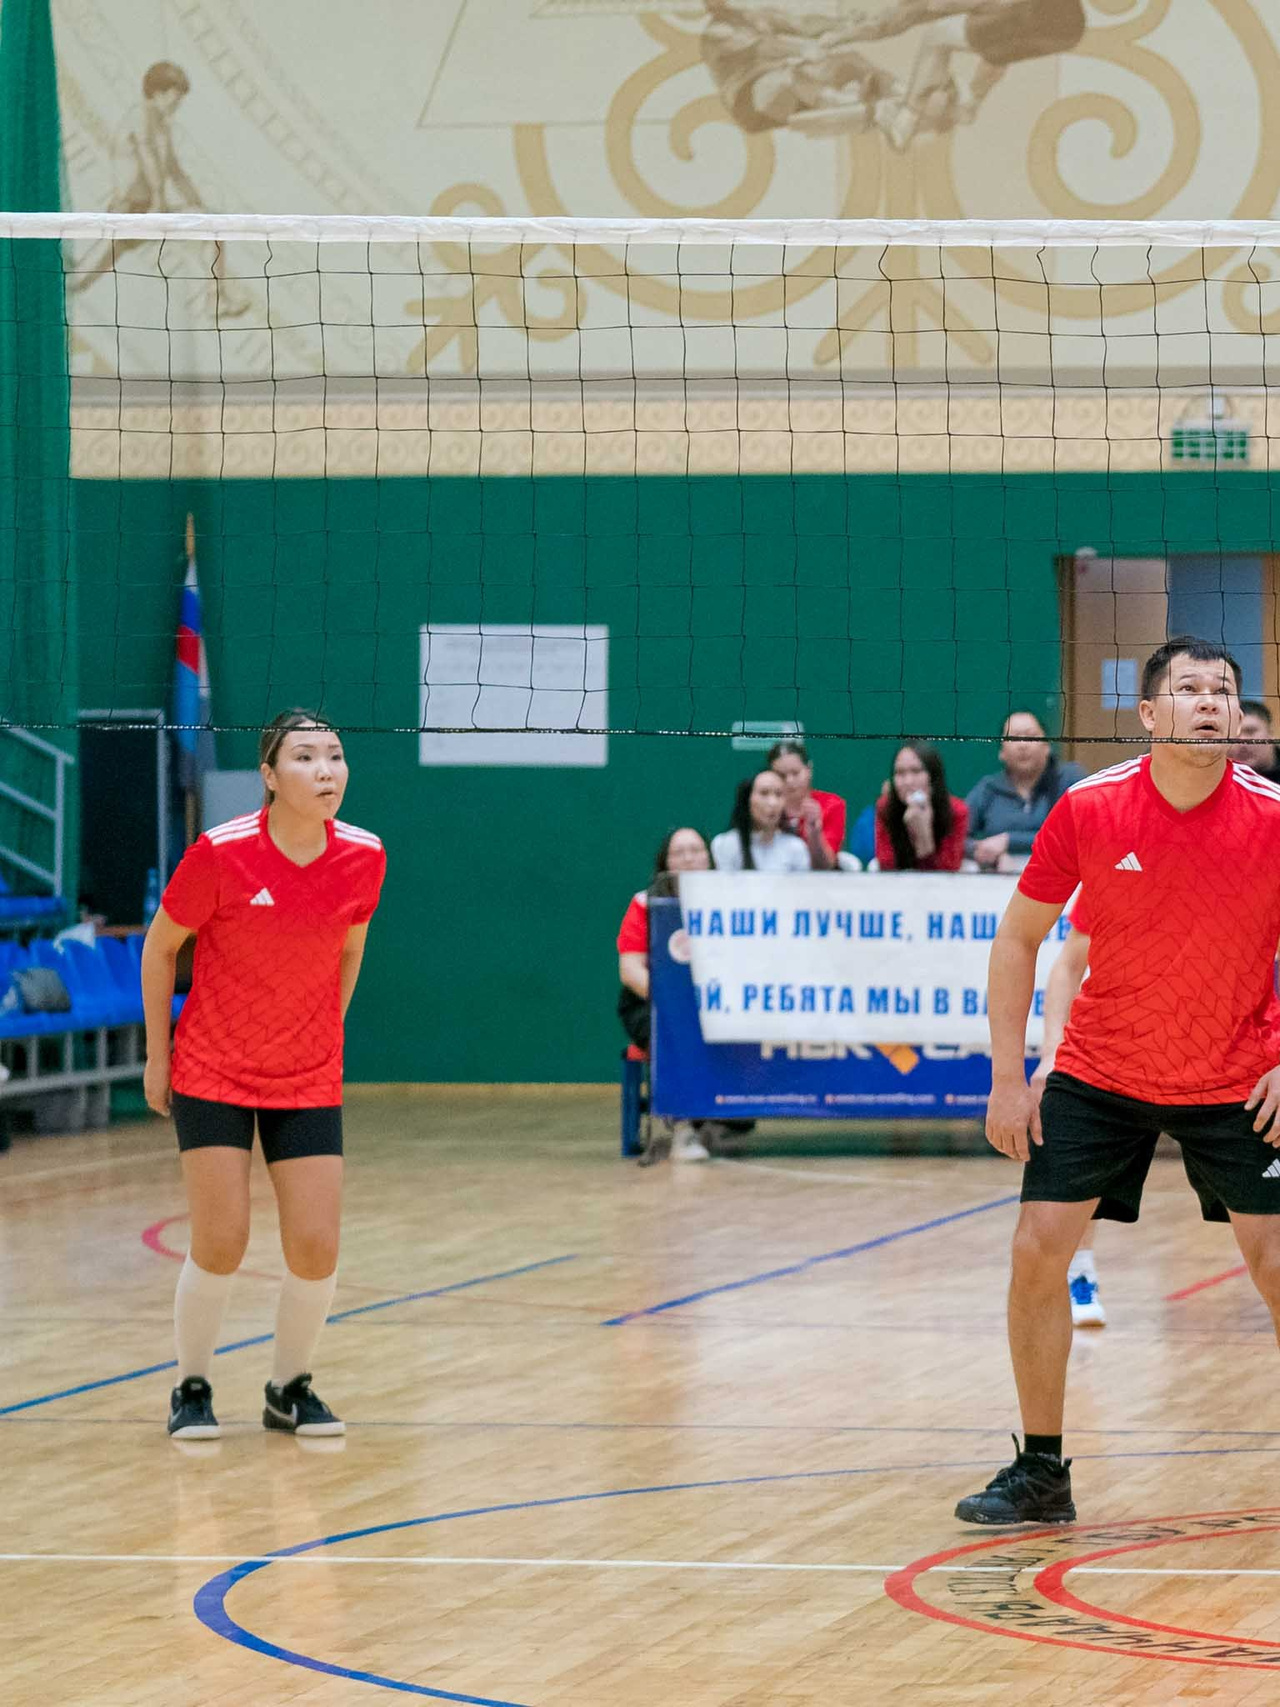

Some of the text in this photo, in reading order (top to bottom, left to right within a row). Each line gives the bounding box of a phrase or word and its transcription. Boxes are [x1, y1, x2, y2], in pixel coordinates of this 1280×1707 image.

[688, 909, 778, 937] НАШИ
[793, 911, 913, 943] ЛУЧШЕ,
[742, 984, 855, 1014] РЕБЯТА
[866, 986, 921, 1015] МЫ
[933, 986, 950, 1016] В
